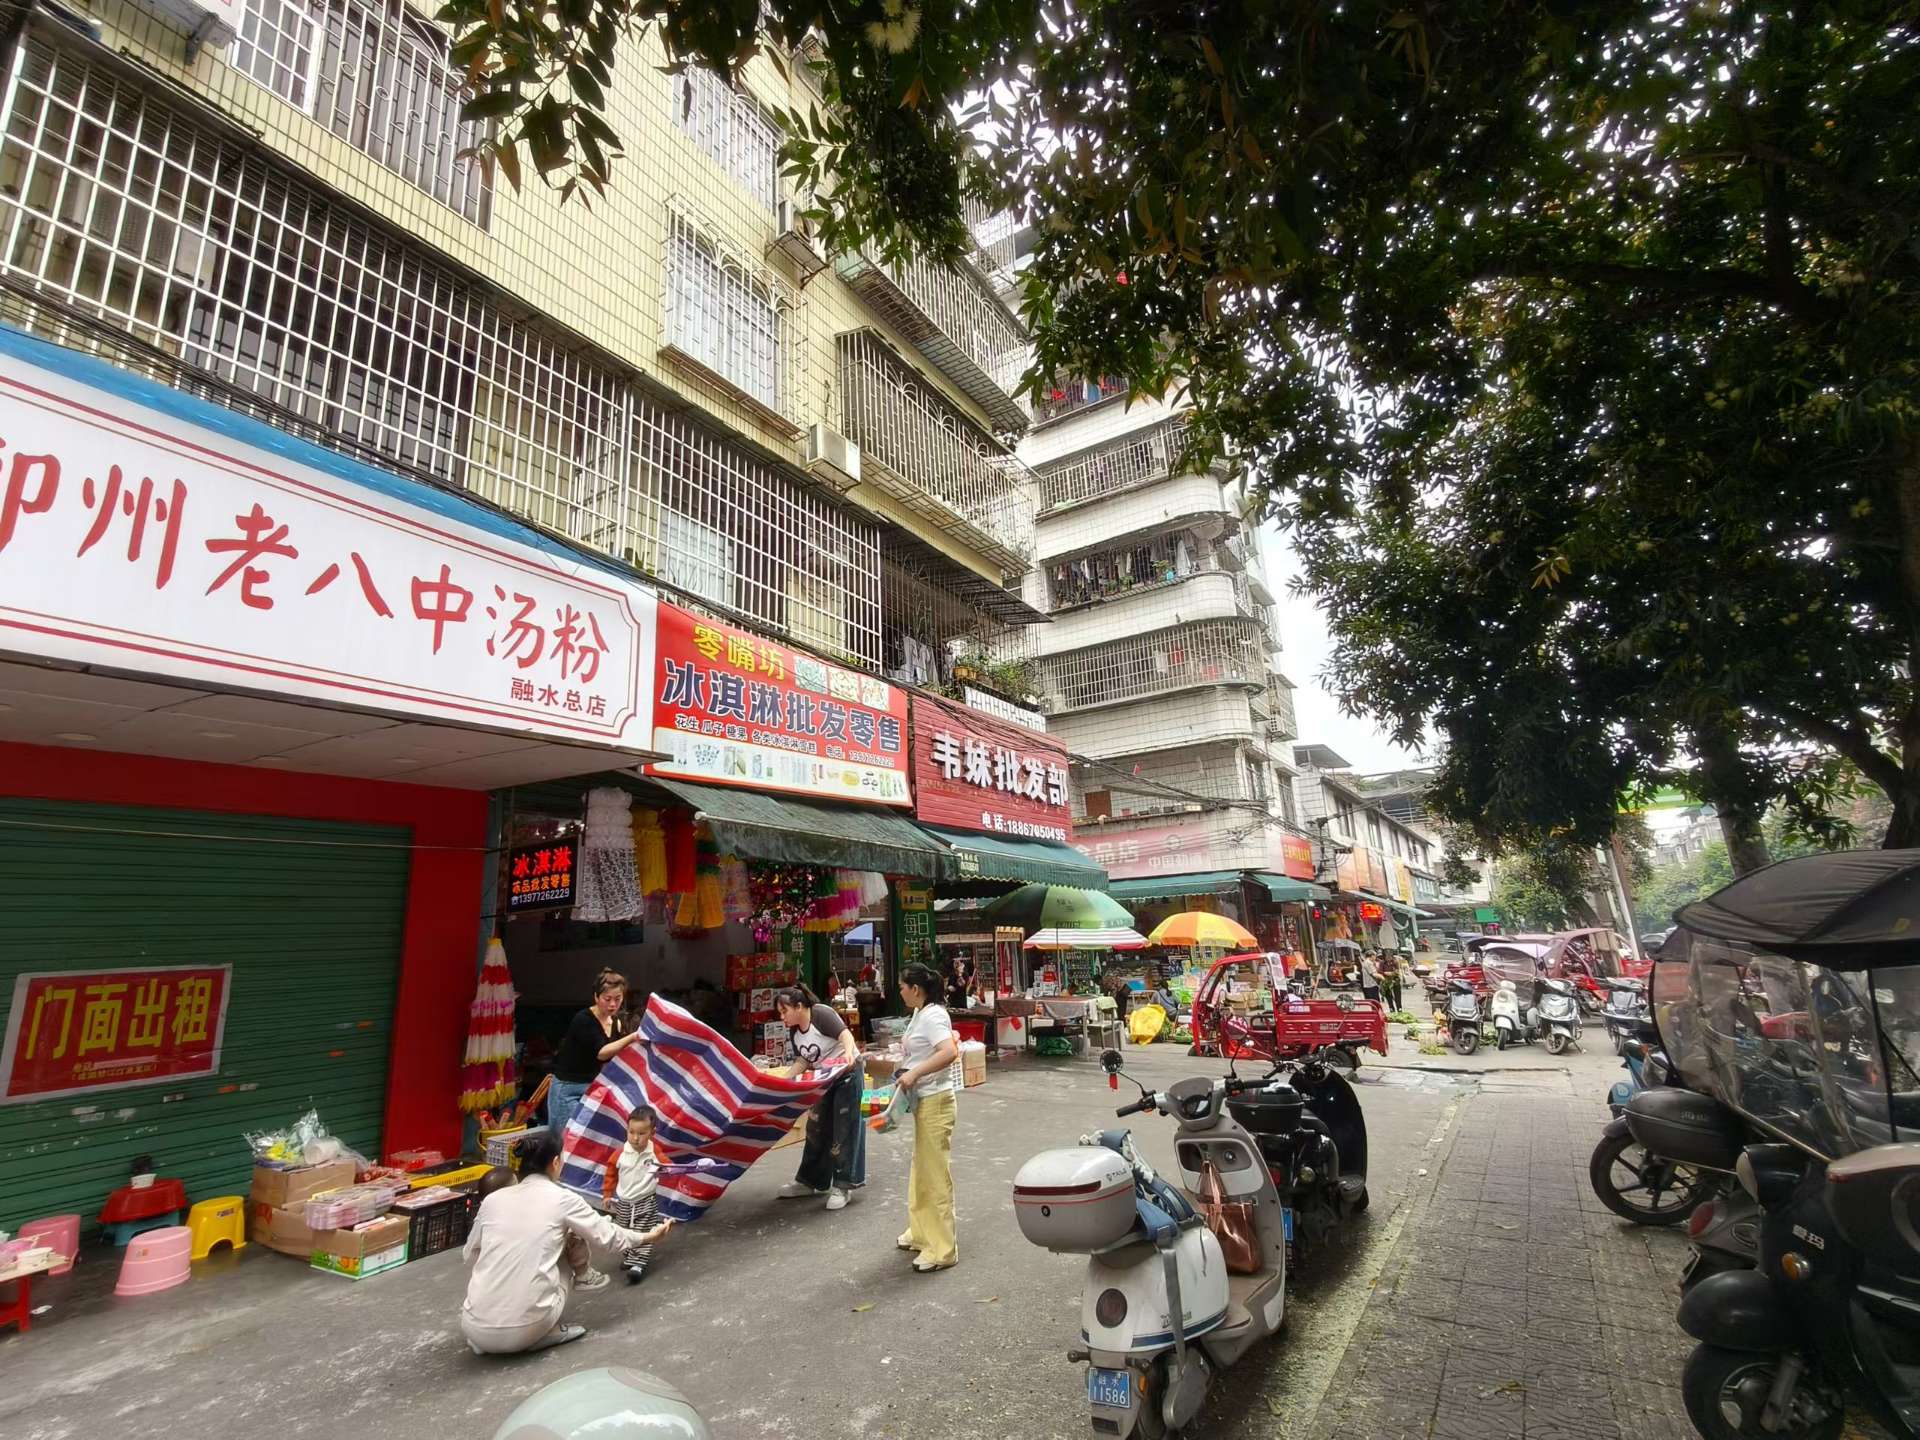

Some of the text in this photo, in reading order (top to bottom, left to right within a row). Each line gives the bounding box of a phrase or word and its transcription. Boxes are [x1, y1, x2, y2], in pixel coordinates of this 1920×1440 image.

[693, 624, 785, 681] 零嘴坊
[510, 677, 607, 717] 融水总店
[661, 658, 901, 754] 冰淇淋批发零售
[931, 731, 1069, 807] 韦妹批发部
[512, 845, 572, 879] 冰淇淋
[25, 976, 212, 1060] 门面出租
[1093, 1385, 1126, 1405] 11586
